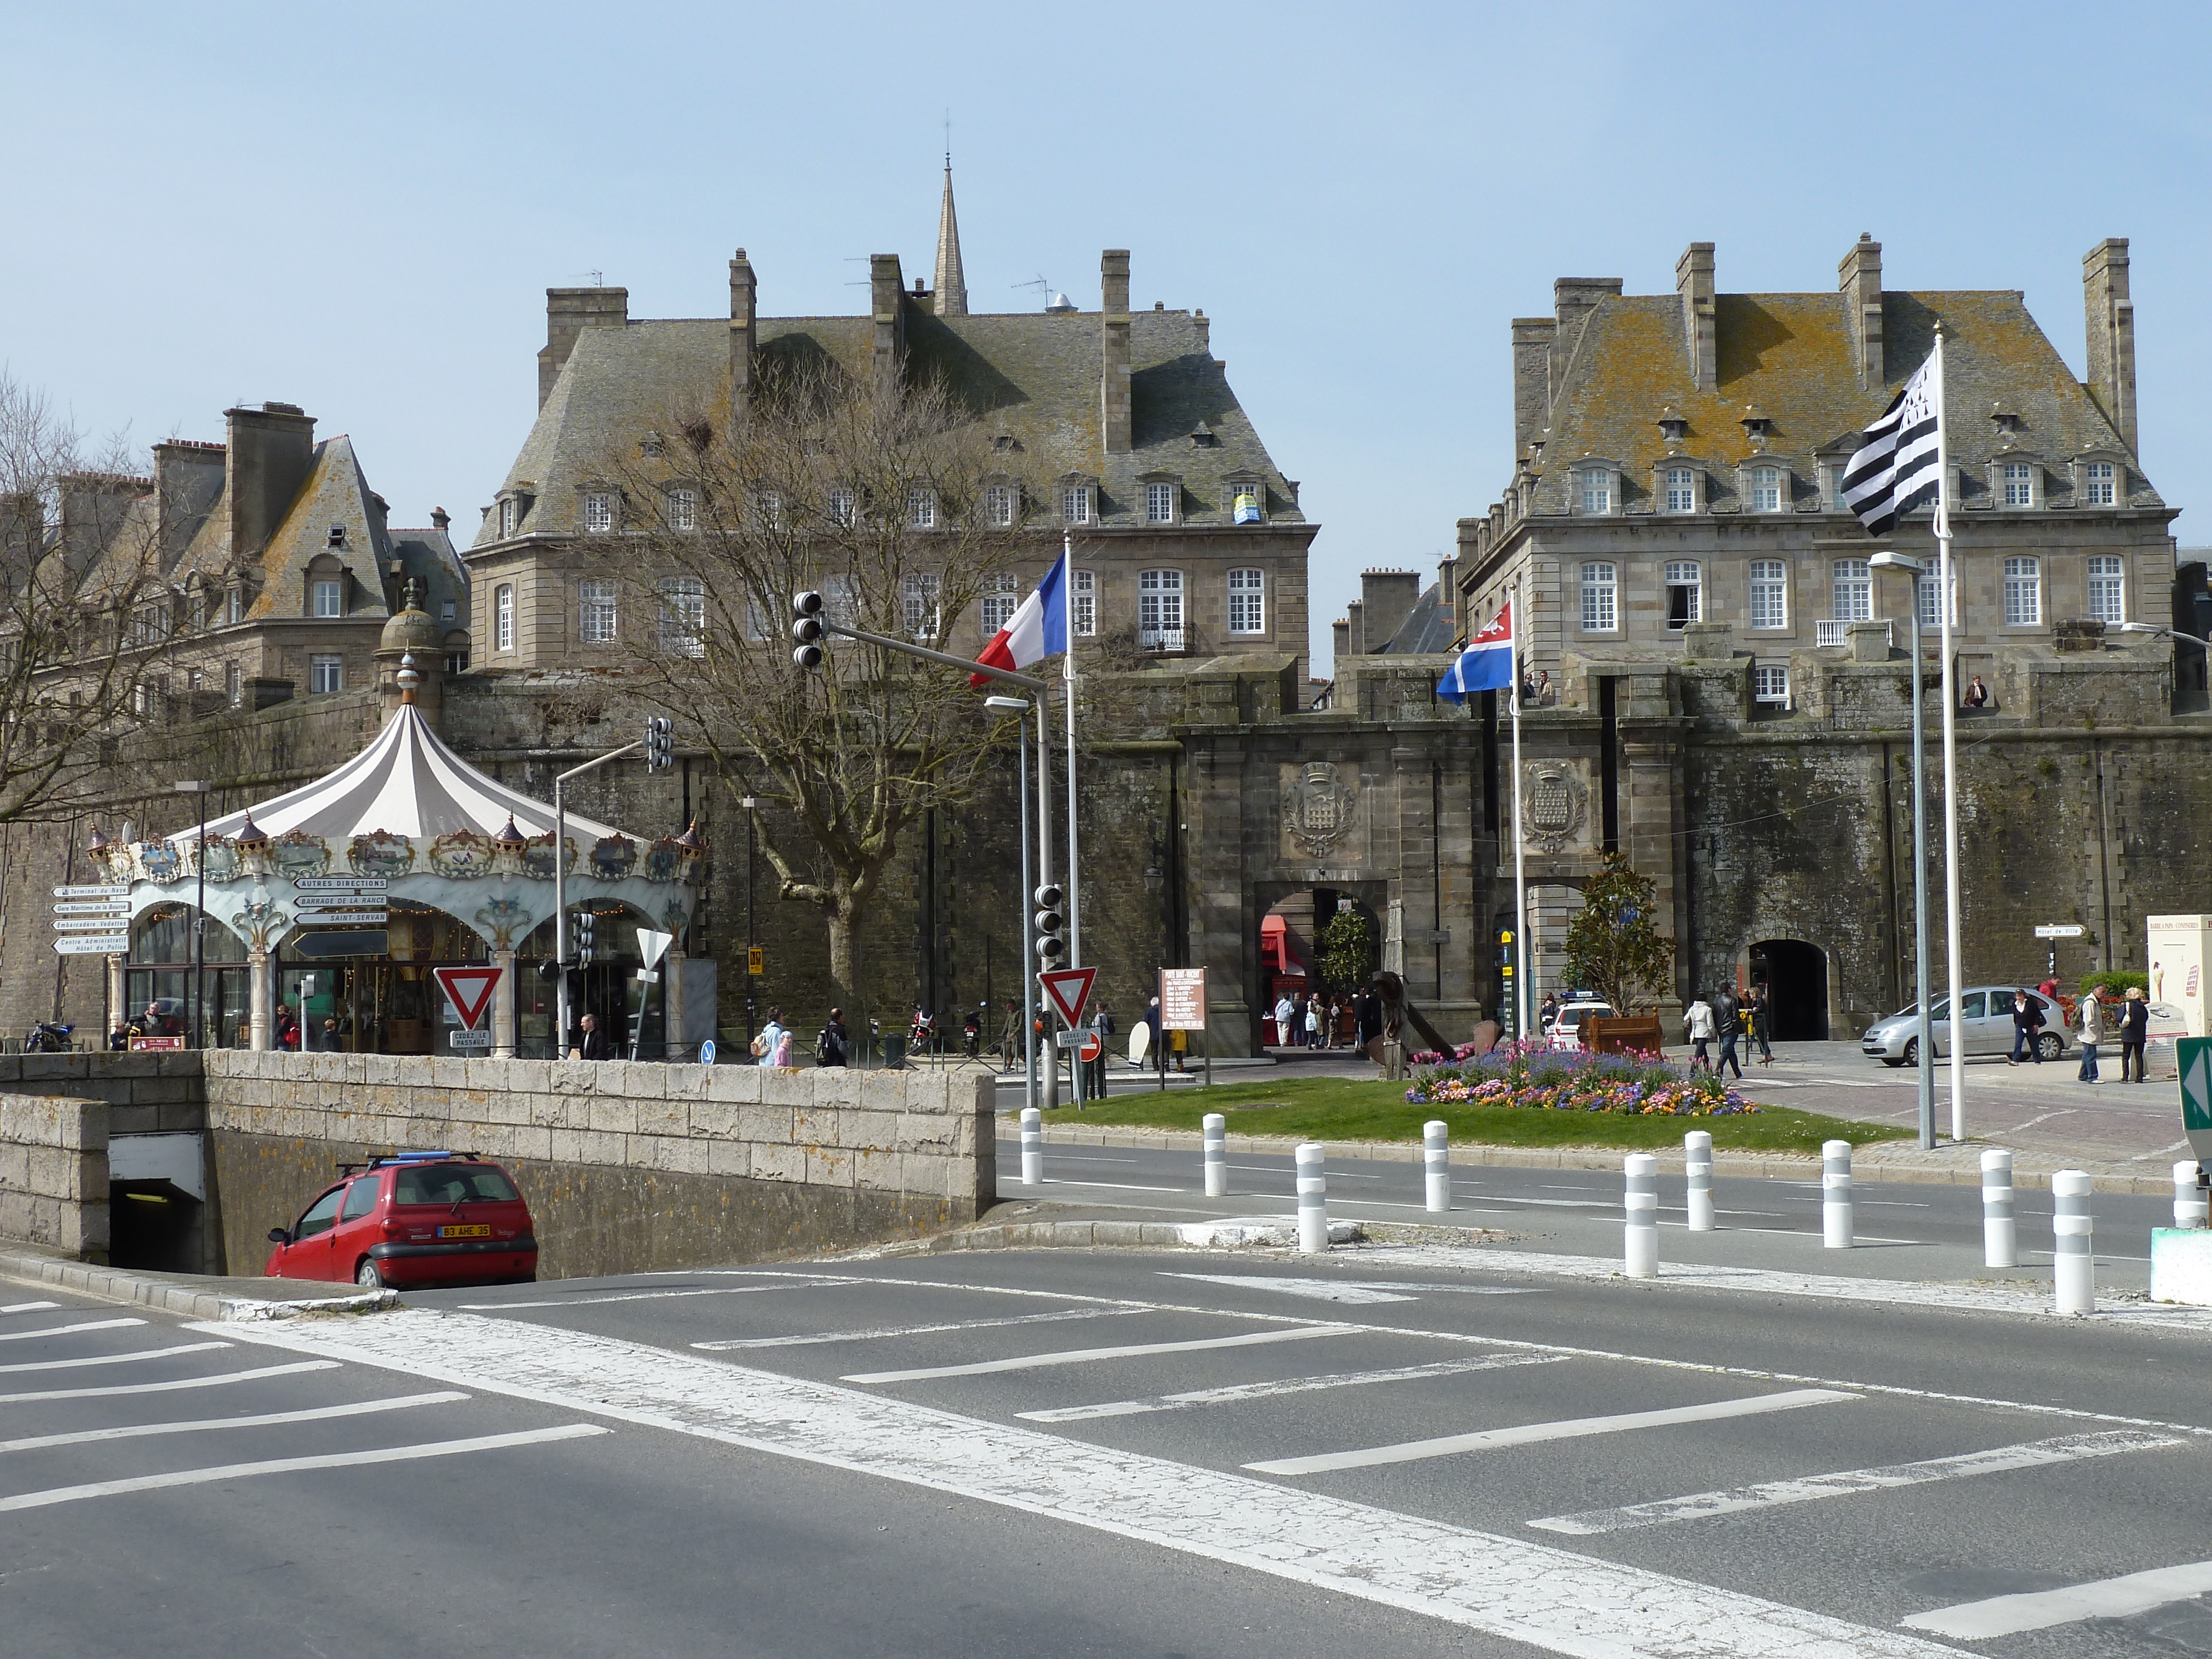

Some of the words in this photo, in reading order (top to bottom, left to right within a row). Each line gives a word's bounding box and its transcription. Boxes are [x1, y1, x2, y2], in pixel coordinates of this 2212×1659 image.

[1235, 508, 1259, 521] GIBOIRE
[444, 1227, 455, 1236] 83
[458, 1227, 474, 1235] AHE
[478, 1226, 488, 1235] 35
